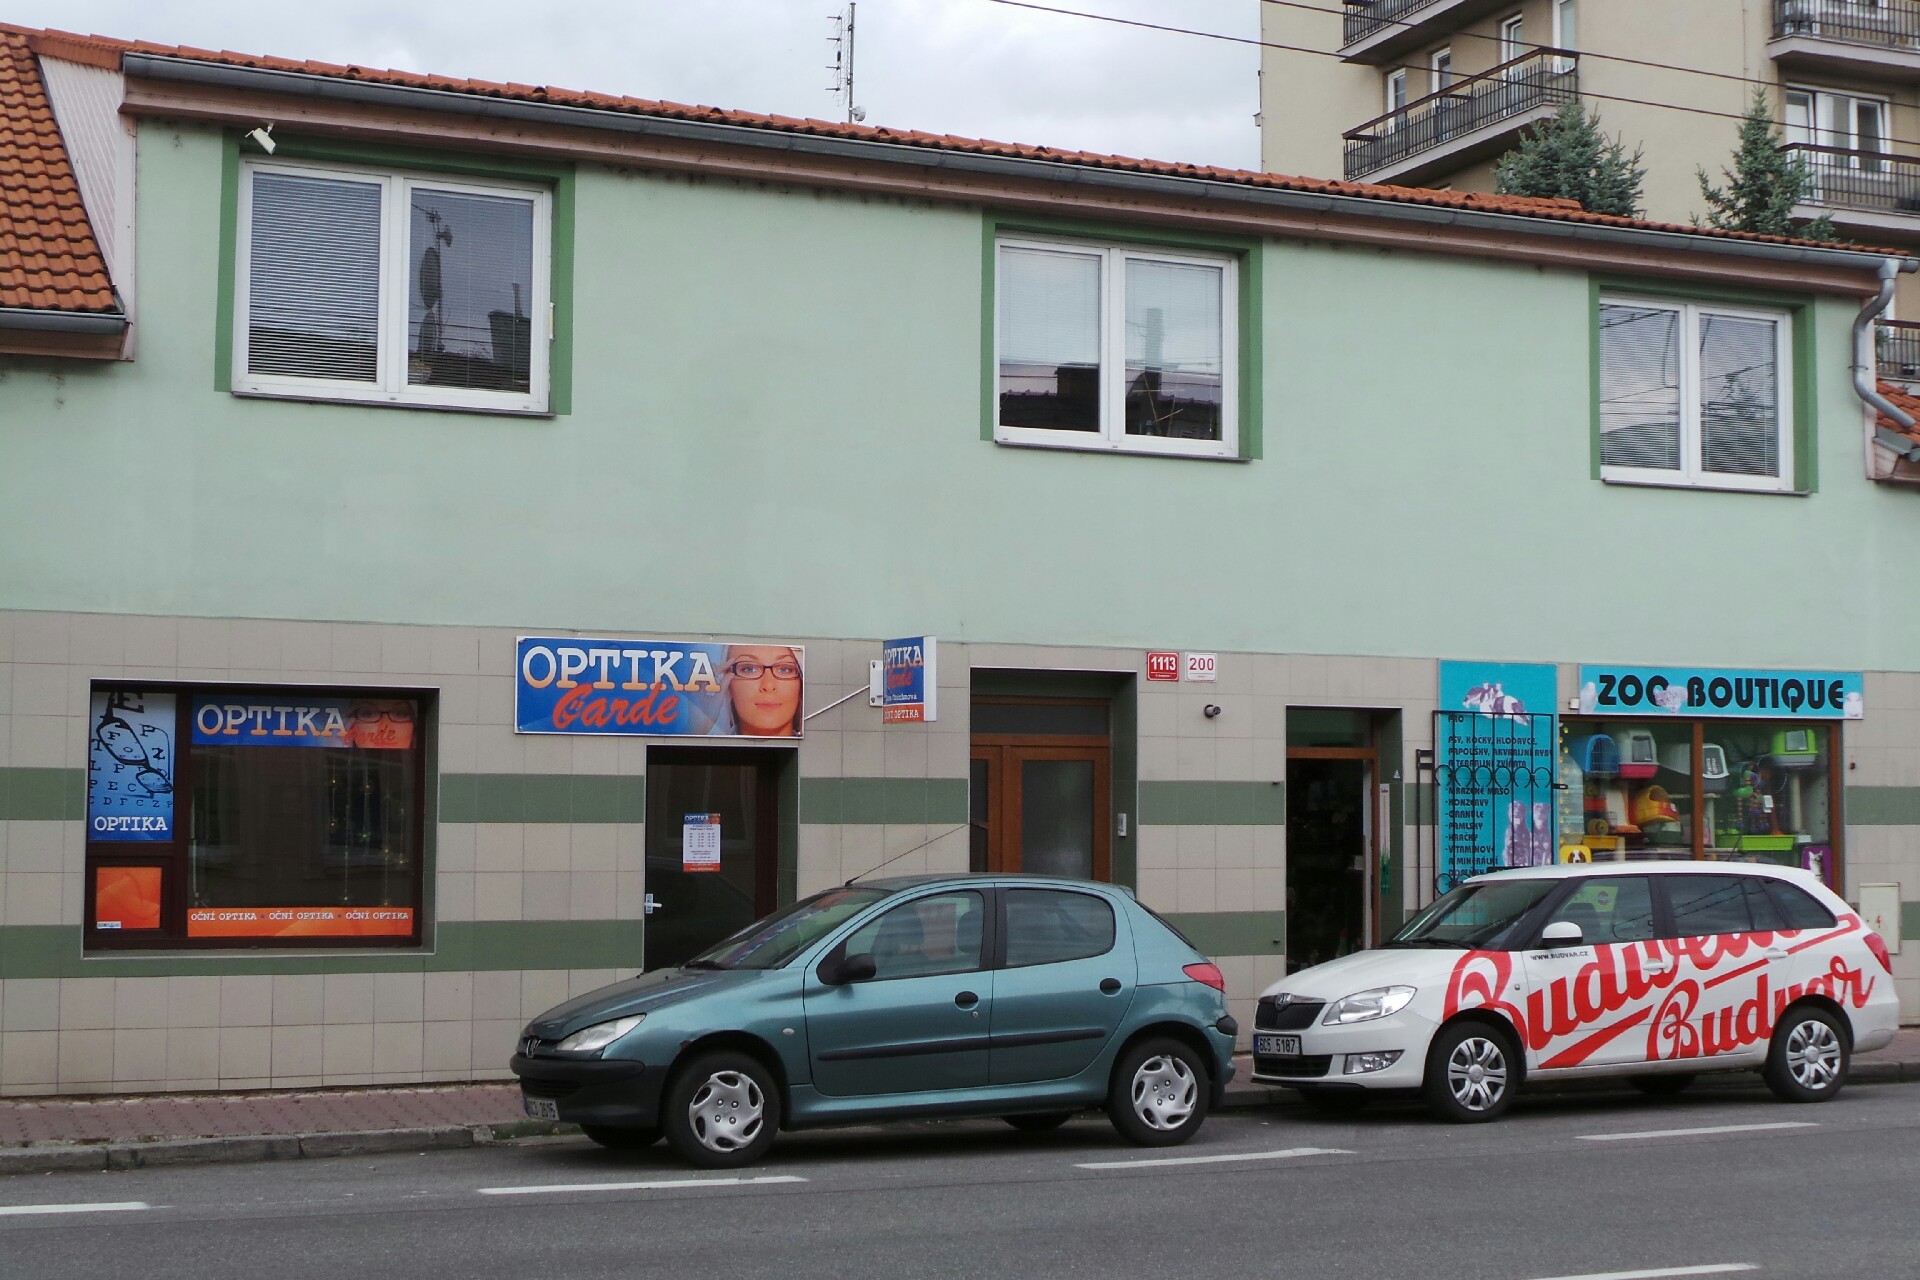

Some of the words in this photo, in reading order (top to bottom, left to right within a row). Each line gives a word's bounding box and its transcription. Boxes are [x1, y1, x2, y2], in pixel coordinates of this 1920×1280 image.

[883, 645, 924, 670] OPTIKA
[1151, 656, 1176, 671] 1113
[1189, 657, 1214, 671] 200
[522, 645, 721, 692] OPTIKA
[1687, 676, 1844, 713] BOUTIQUE
[552, 682, 680, 729] Garde
[197, 704, 348, 737] OPTIKA
[894, 709, 919, 719] OPTIKA
[1448, 715, 1464, 723] PRO
[1493, 748, 1534, 757] AKVARIJN
[1456, 760, 1494, 768] TERARIJN
[94, 816, 168, 832] OPTIKA
[191, 910, 216, 921] OČNÍ
[218, 912, 257, 921] OPTIKA
[269, 910, 293, 920] OČNÍ
[296, 911, 334, 920] OPTIKA
[345, 910, 370, 920] OČNÍ
[372, 911, 408, 920] OPTIKA
[1276, 1038, 1296, 1053] 5187
